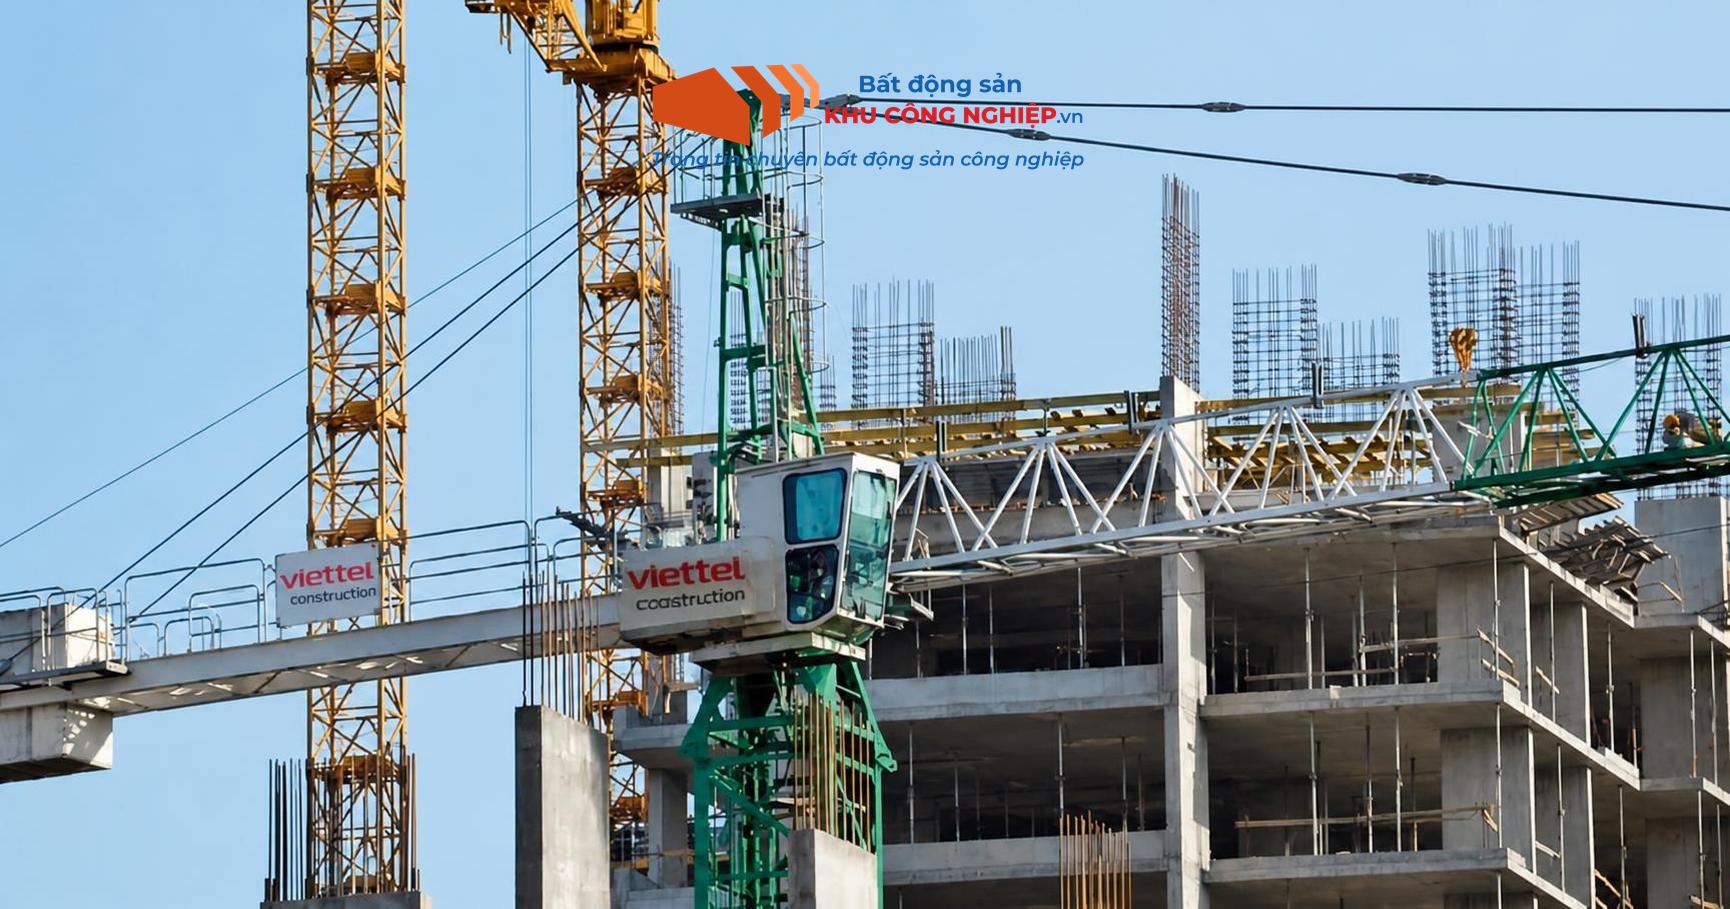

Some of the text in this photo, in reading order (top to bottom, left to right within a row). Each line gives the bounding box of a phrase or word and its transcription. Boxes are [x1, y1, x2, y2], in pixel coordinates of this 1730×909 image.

[280, 560, 375, 590] viettel
[627, 556, 746, 590] viettel
[290, 587, 377, 605] construction
